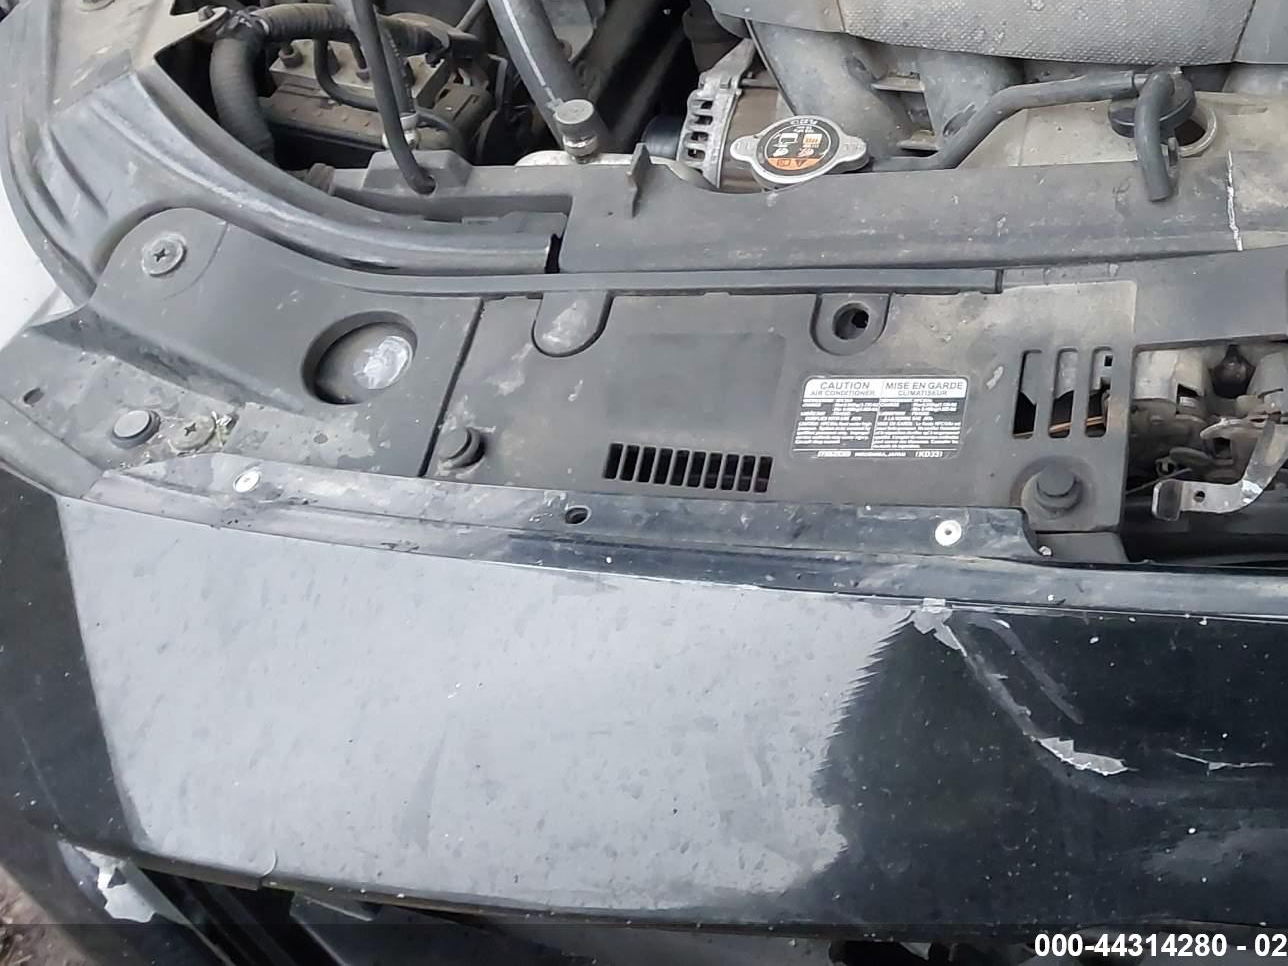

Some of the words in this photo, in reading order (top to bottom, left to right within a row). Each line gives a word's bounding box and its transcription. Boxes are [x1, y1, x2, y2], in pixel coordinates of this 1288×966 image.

[820, 381, 870, 390] CAUTION
[885, 382, 910, 390] MISE
[911, 382, 926, 390] EN
[927, 382, 963, 390] GARDE
